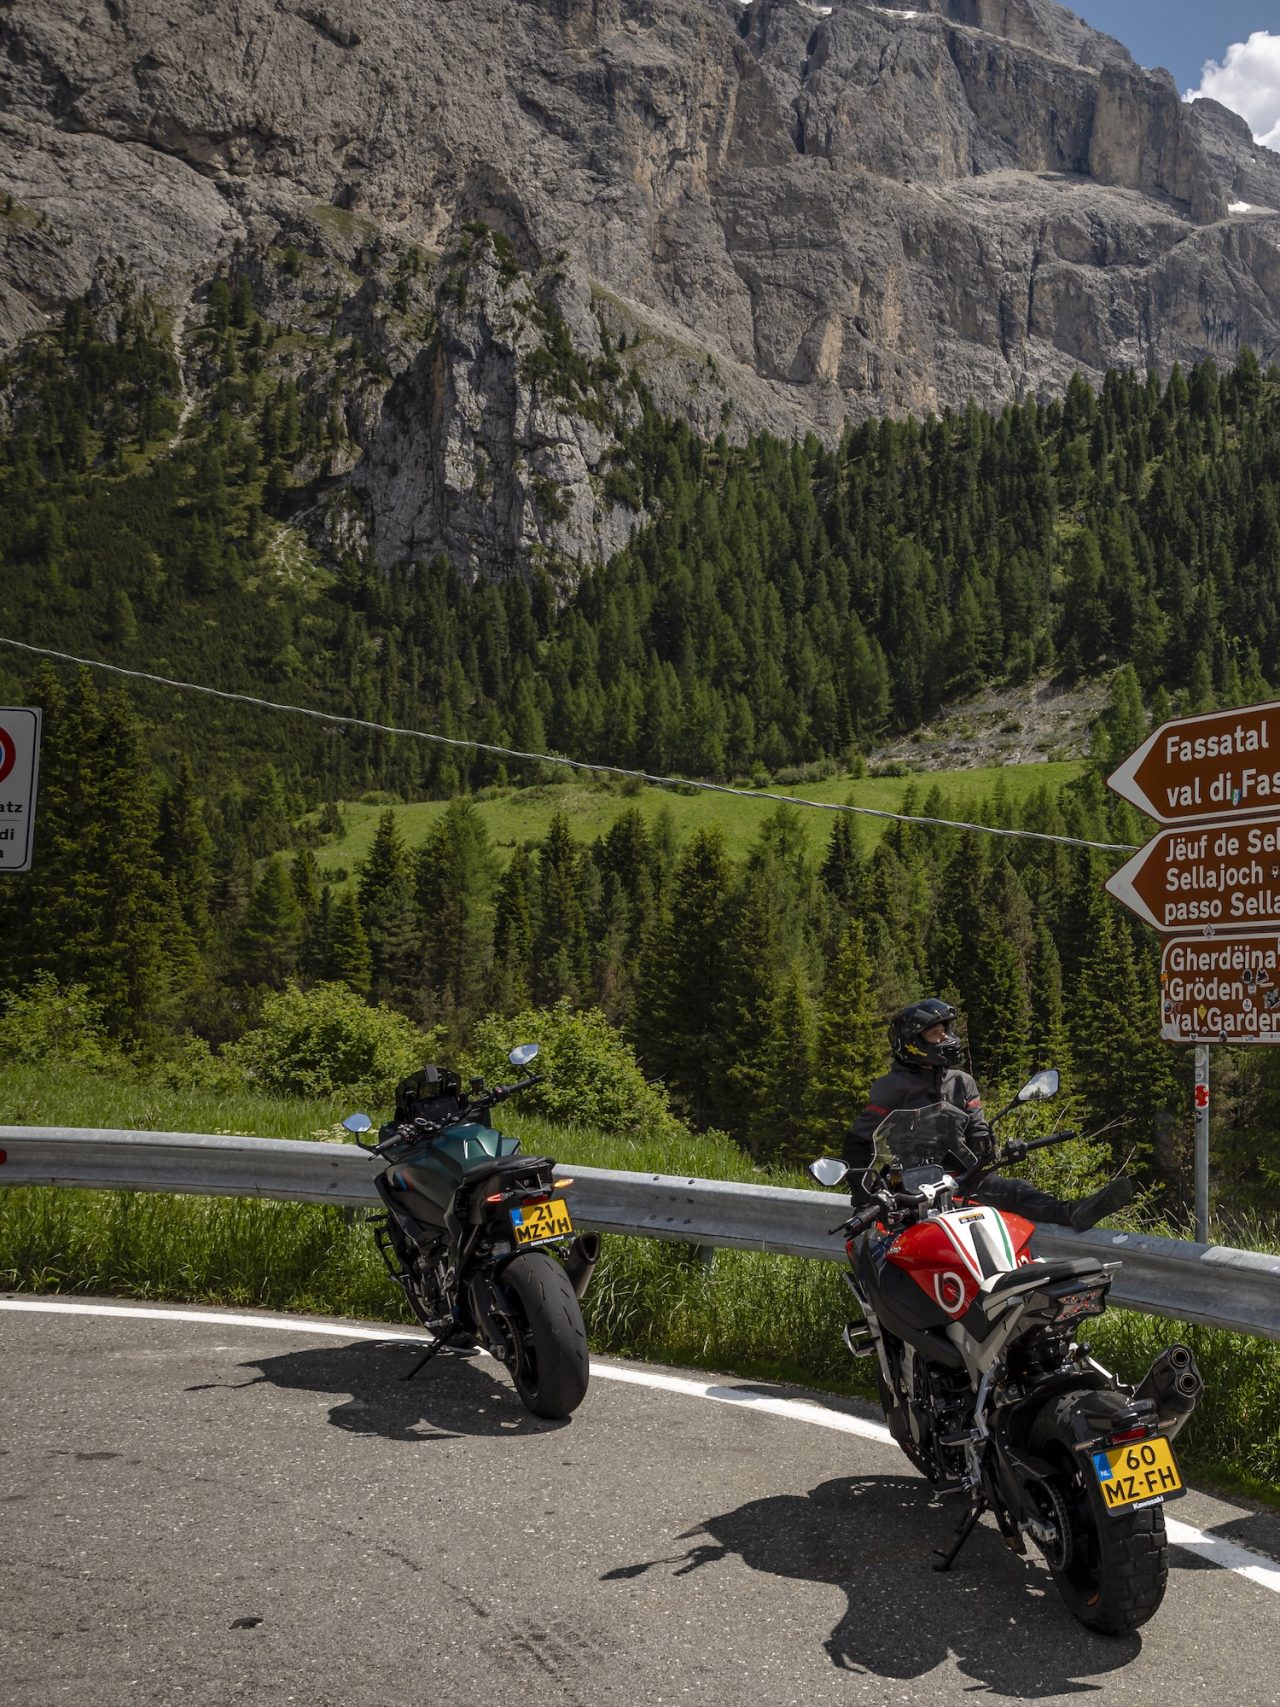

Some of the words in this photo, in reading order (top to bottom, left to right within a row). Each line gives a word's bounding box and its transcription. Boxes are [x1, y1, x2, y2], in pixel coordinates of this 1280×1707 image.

[1166, 720, 1269, 763] Fassatal
[1167, 777, 1201, 807] val
[1210, 772, 1232, 801] di
[1166, 837, 1208, 862] Jëuf
[1214, 833, 1240, 857] de
[1165, 861, 1263, 892] Sellajoch
[1165, 898, 1222, 925] passo
[1170, 945, 1276, 972] Gherdëina
[1169, 977, 1244, 1001] Gröden
[1170, 1007, 1200, 1032] val
[535, 1204, 553, 1221] 21
[516, 1217, 570, 1242] MZ-VH
[1126, 1445, 1156, 1470] 60
[1104, 1465, 1177, 1504] MZ-FH
[1132, 1495, 1164, 1510] Kawasaki
